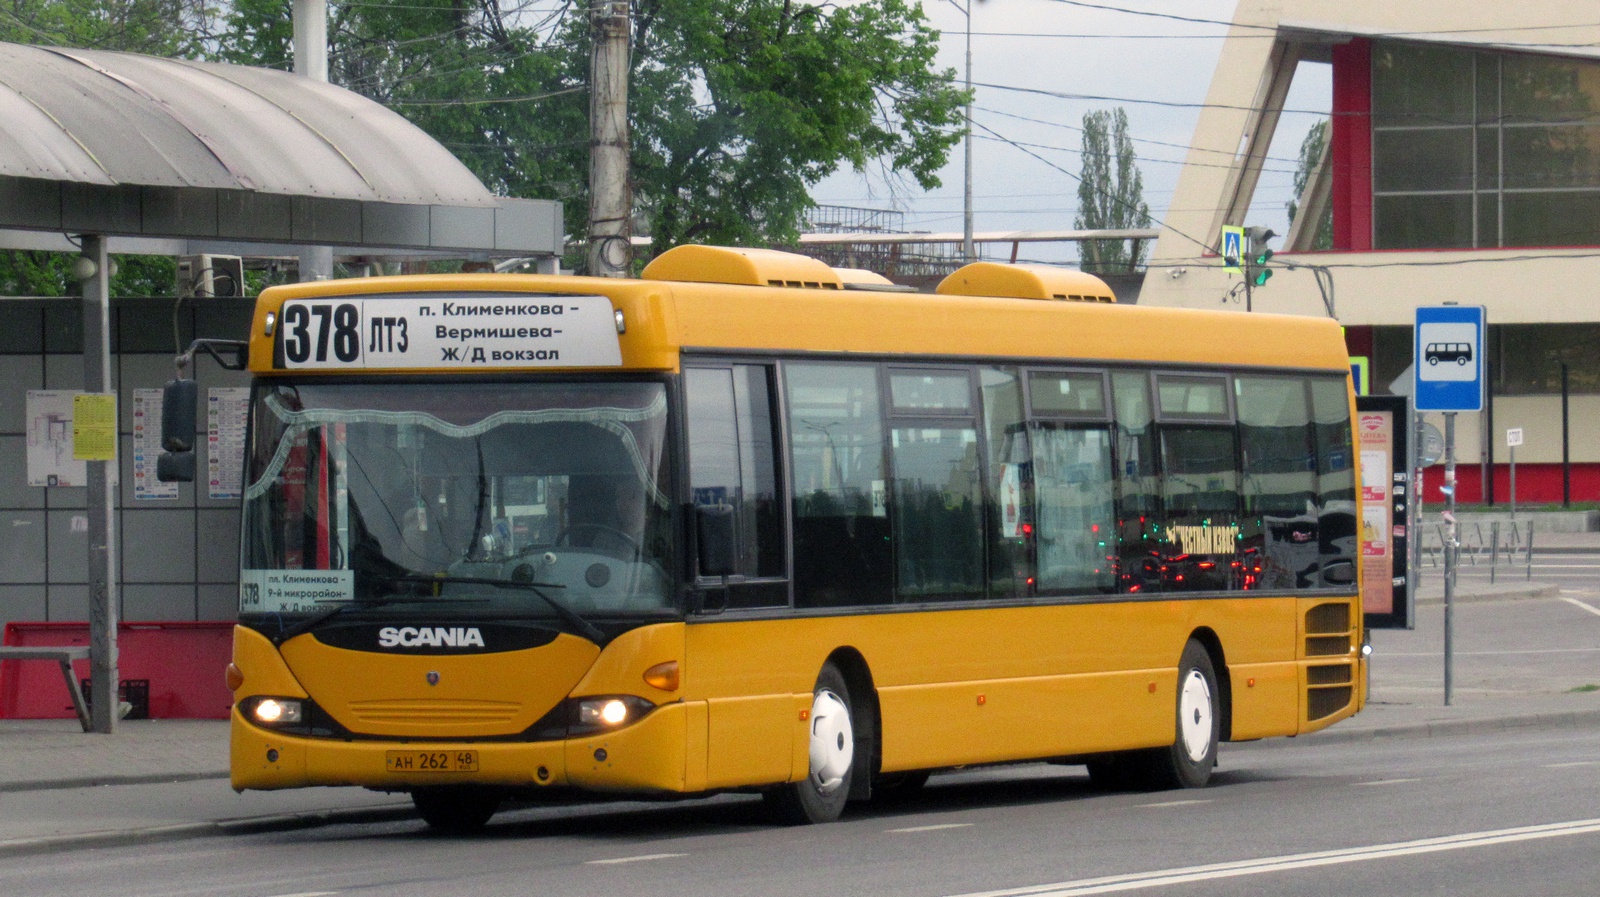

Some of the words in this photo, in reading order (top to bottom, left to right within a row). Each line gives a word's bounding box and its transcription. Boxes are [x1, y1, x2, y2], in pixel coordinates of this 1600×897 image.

[420, 305, 435, 316] п.
[443, 303, 563, 316] Клименкова
[285, 304, 359, 363] 378
[370, 317, 409, 353] ЛТЗ
[441, 346, 486, 363] Ж/Д
[493, 347, 560, 361] вокзал
[283, 575, 338, 583] Клименкова
[243, 583, 259, 604] 378
[268, 589, 282, 597] 9-й
[378, 627, 485, 648] SCANIA
[420, 753, 447, 768] 262
[458, 753, 472, 764] 48
